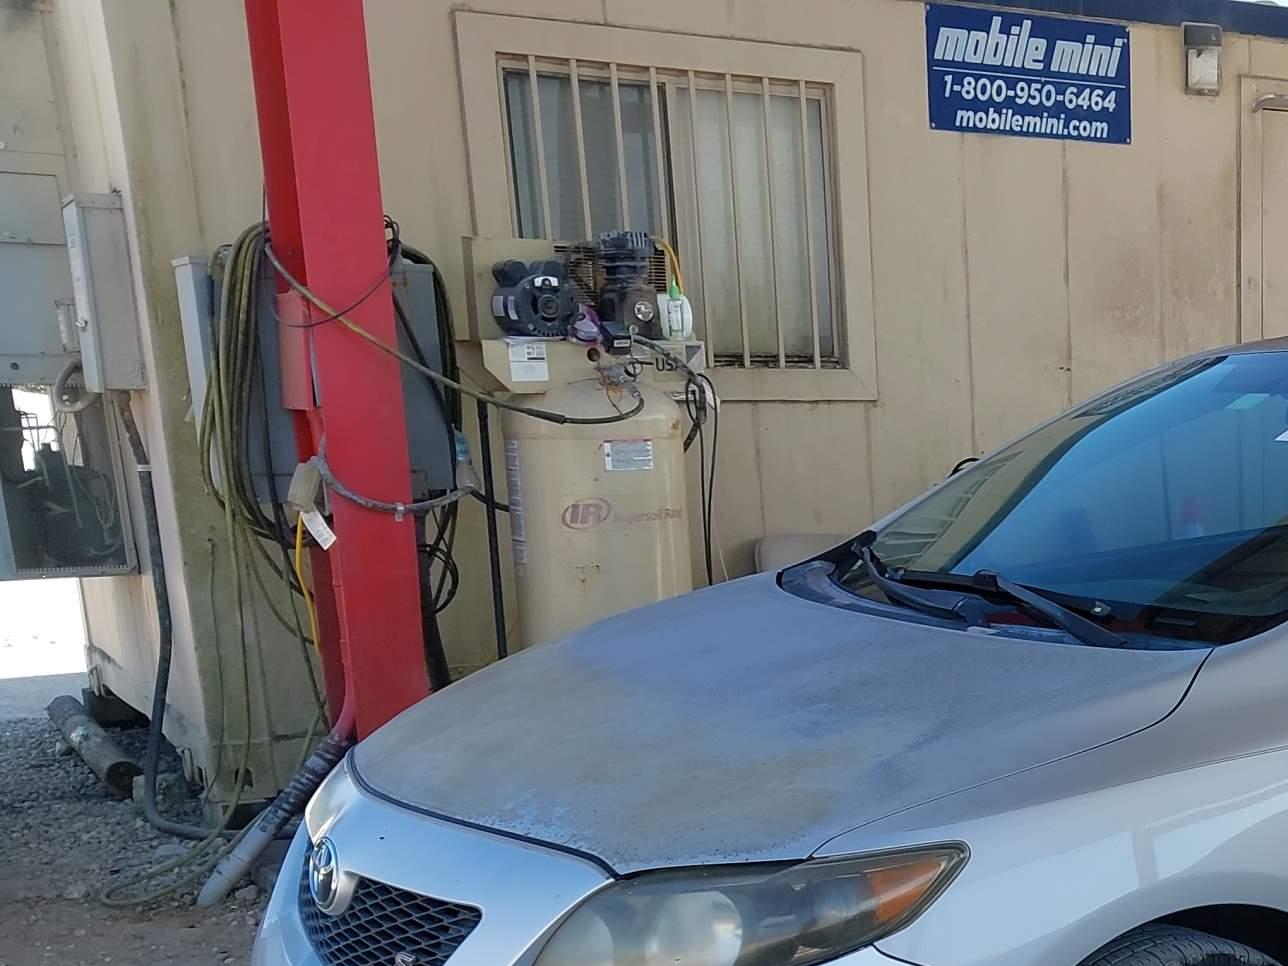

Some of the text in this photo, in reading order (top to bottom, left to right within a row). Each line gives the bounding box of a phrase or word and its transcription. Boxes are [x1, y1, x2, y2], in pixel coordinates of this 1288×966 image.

[933, 16, 1122, 78] mobile mini
[943, 75, 1116, 112] 1-800-950-6464
[955, 108, 1109, 138] mobilemini.com
[655, 357, 678, 372] US
